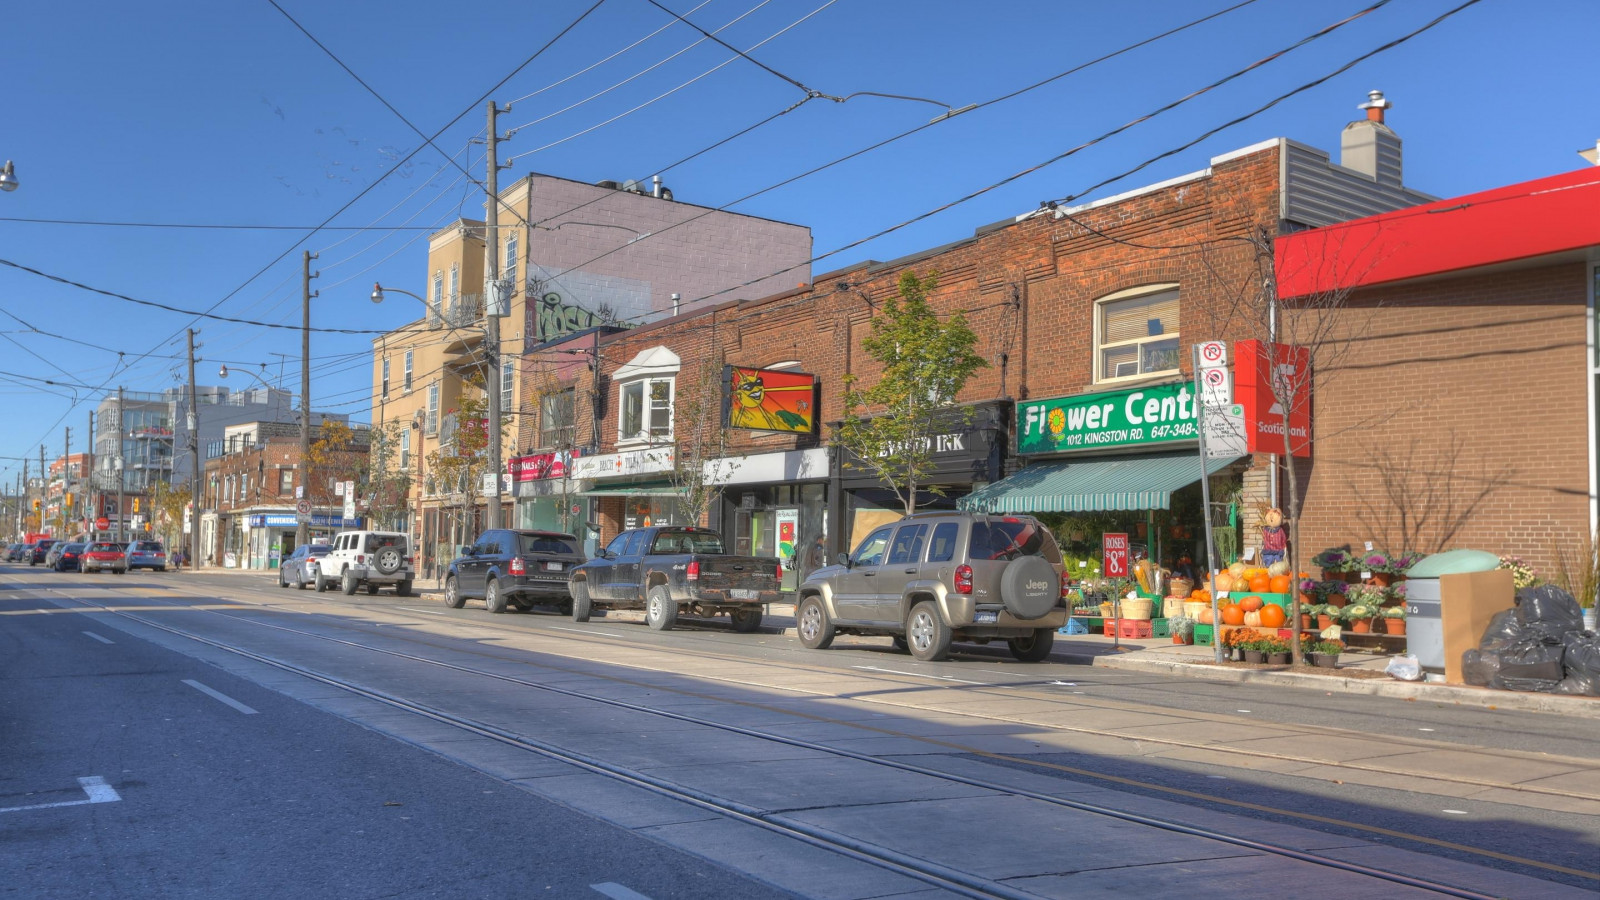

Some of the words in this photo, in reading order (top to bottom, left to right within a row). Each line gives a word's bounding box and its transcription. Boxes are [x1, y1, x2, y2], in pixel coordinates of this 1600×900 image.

[1125, 387, 1204, 425] Cent
[1067, 434, 1082, 446] 1012
[1085, 429, 1128, 444] KINGSTON
[1130, 428, 1144, 440] RD.
[1258, 421, 1307, 437] Scotiaank
[936, 433, 965, 452] INK
[311, 517, 357, 525] CONVENINCE
[1105, 537, 1125, 549] ROSES
[1025, 579, 1048, 591] Jeep
